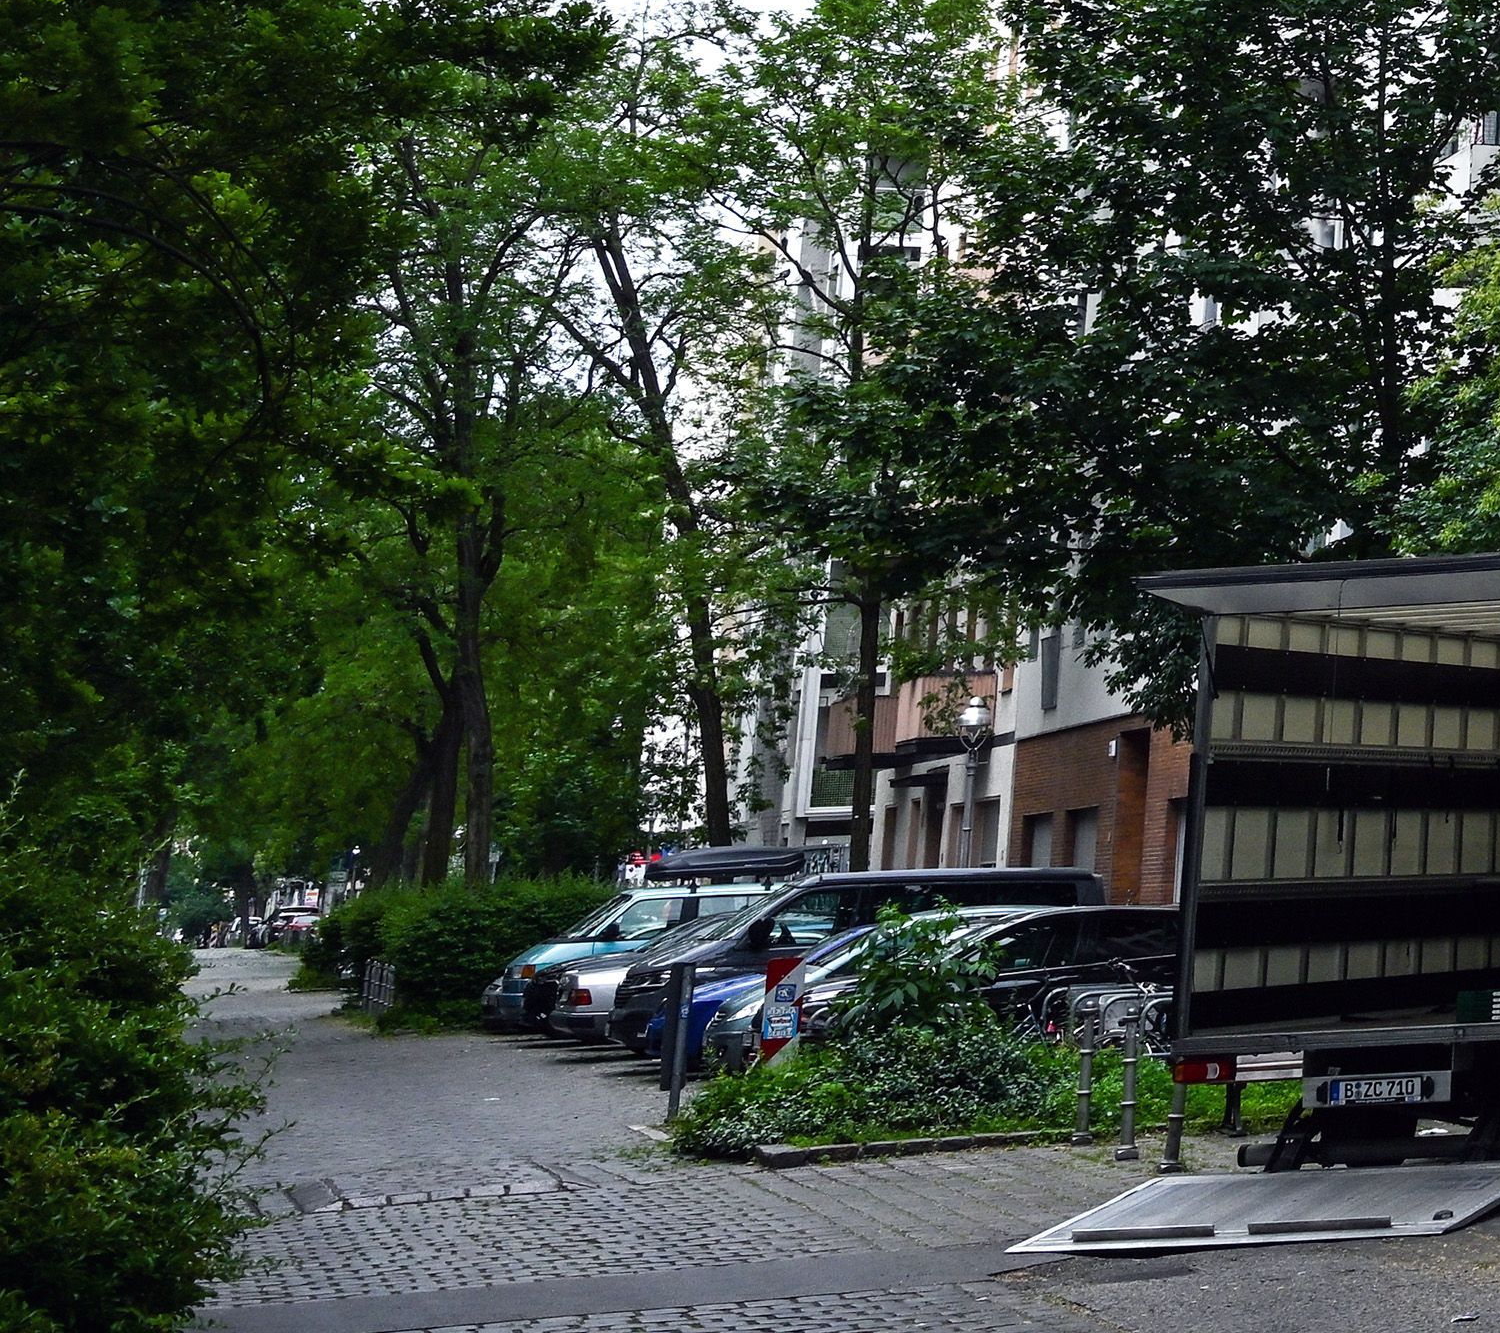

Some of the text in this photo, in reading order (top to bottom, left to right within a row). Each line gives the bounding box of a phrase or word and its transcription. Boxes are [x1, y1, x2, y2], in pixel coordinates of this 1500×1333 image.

[1344, 1079, 1415, 1099] B ZC 710
